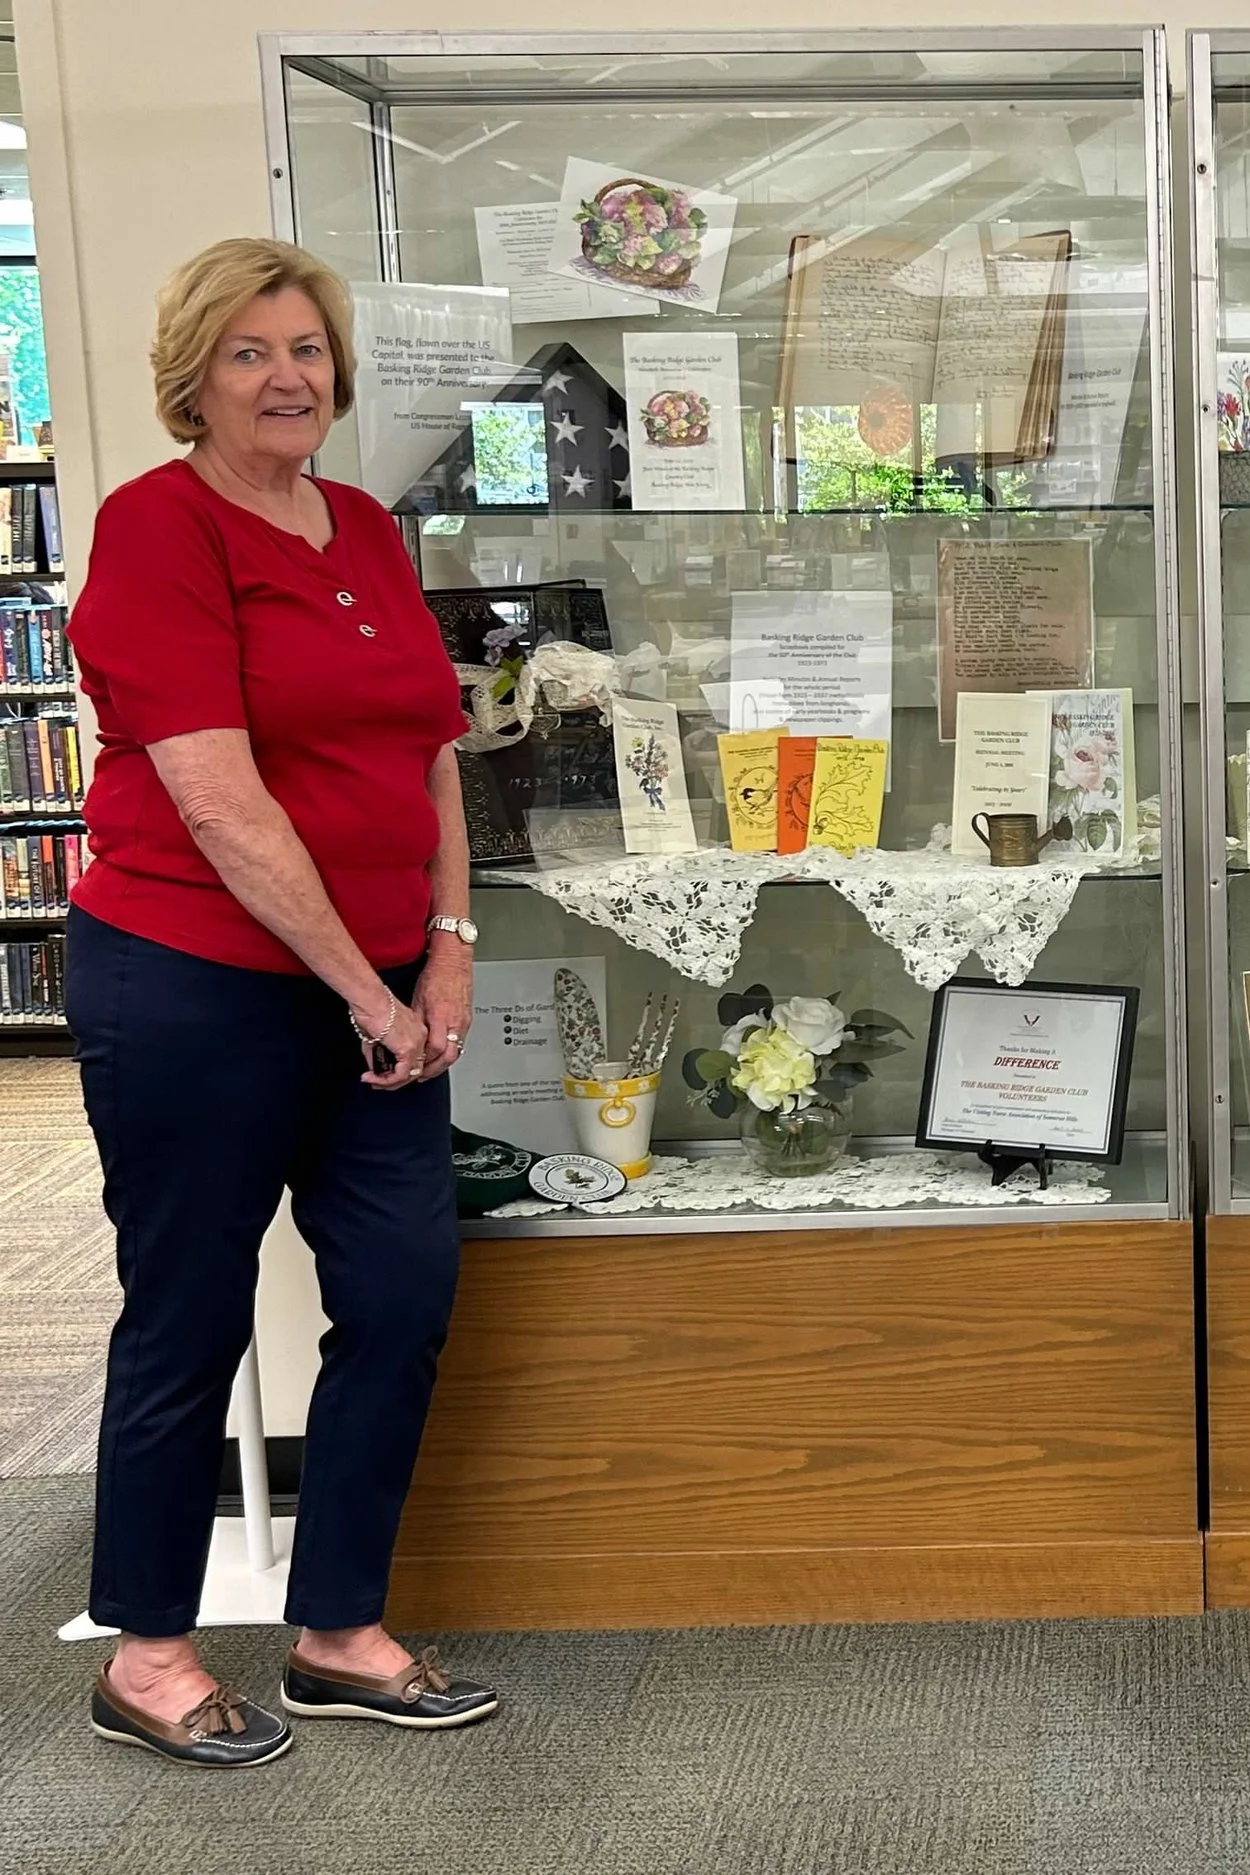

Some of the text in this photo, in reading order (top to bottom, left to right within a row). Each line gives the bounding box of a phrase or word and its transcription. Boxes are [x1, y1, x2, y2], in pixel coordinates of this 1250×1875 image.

[376, 336, 393, 347] This
[442, 340, 461, 348] over
[462, 340, 476, 349] the
[408, 352, 424, 360] was
[426, 352, 469, 362] presented
[378, 363, 411, 375] Basking
[413, 364, 437, 375] Ridge
[439, 365, 470, 375] Garden
[395, 378, 414, 386] their
[761, 634, 864, 642] Basking Ridge Garden Club
[491, 1006, 513, 1014] Three
[526, 1004, 535, 1012] of
[536, 1003, 555, 1011] Gard
[514, 1038, 547, 1047] Drainage
[994, 1056, 1061, 1070] DIFFERENCE
[960, 1080, 1088, 1097] THE BASKING RIDGE GARDEN CLUB
[999, 1092, 1048, 1102] VOLUNTEERS
[538, 1156, 591, 1171] BASKING
[534, 1181, 579, 1201] GARDEN
